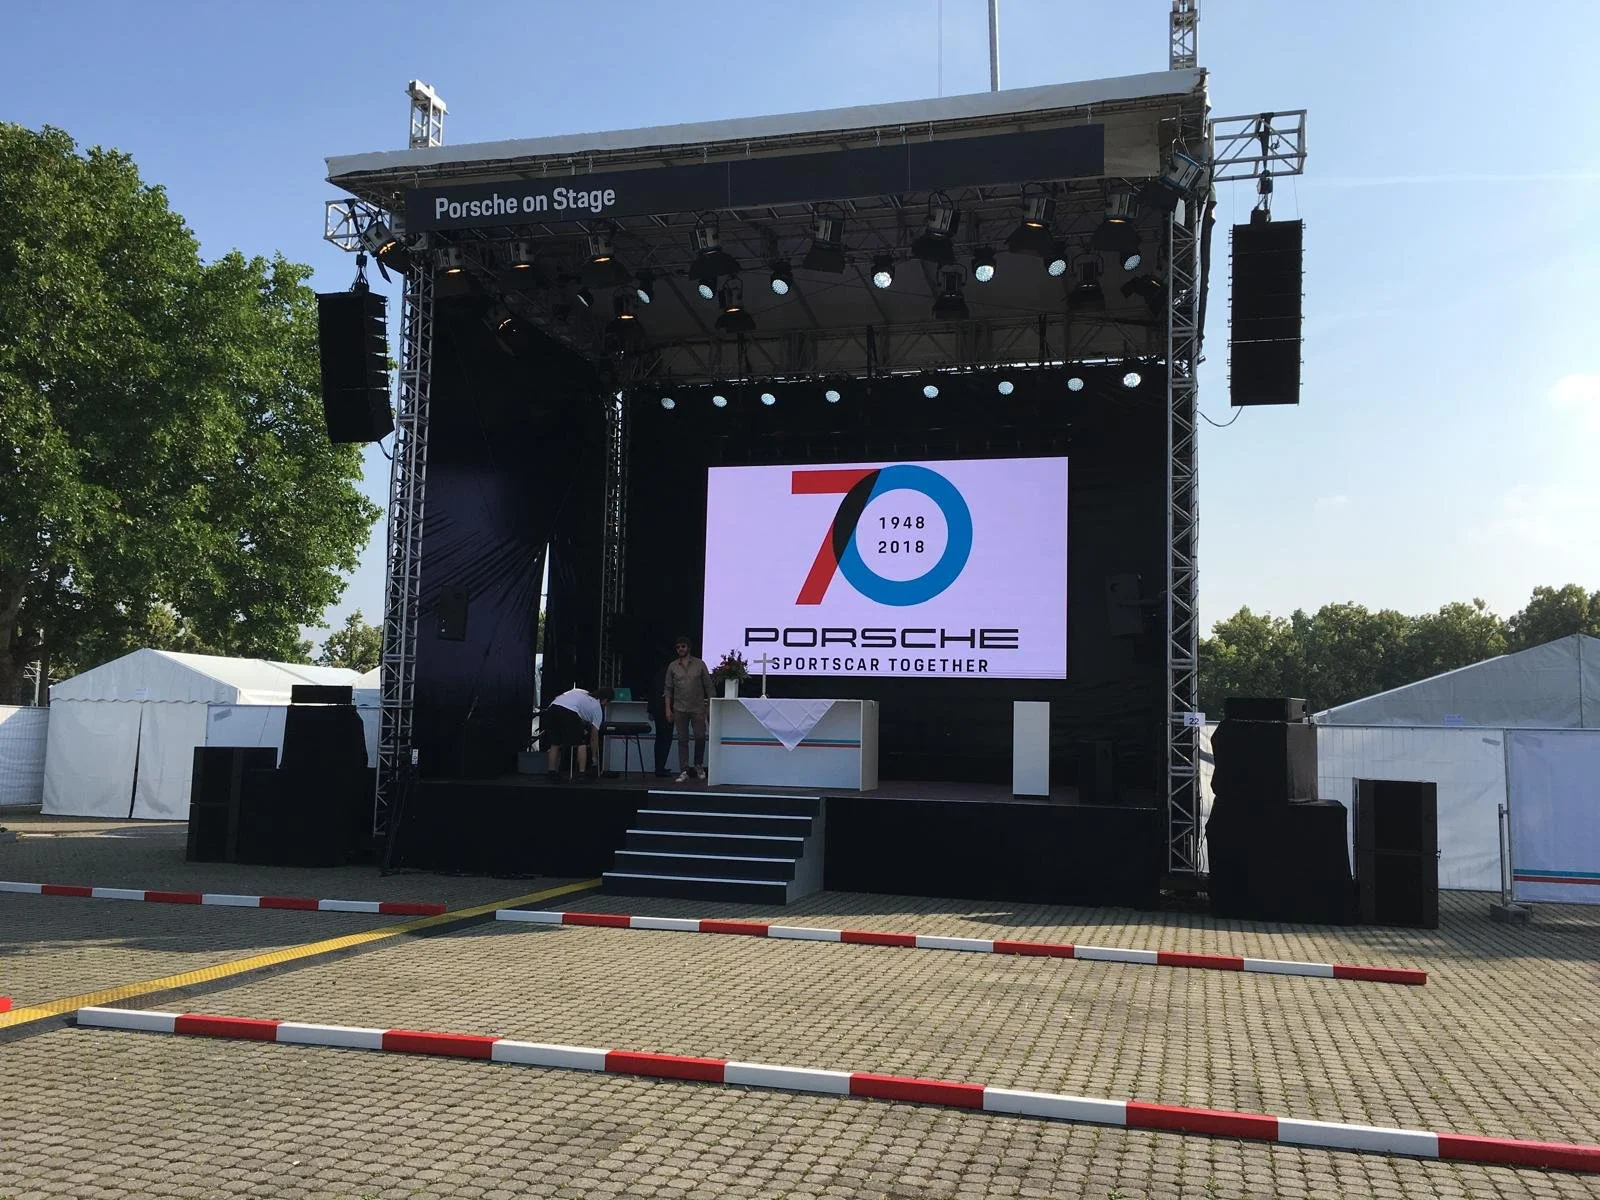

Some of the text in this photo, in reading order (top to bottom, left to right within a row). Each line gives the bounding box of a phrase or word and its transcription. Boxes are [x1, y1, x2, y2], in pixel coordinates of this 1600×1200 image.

[435, 187, 616, 219] Porsche on Stage
[879, 516, 925, 530] 1948
[791, 464, 974, 607] 70
[878, 540, 925, 554] 2018
[744, 627, 1019, 650] PORSCHE
[771, 657, 988, 673] SPORTSCAR TOGETHER
[1189, 717, 1200, 725] 22
